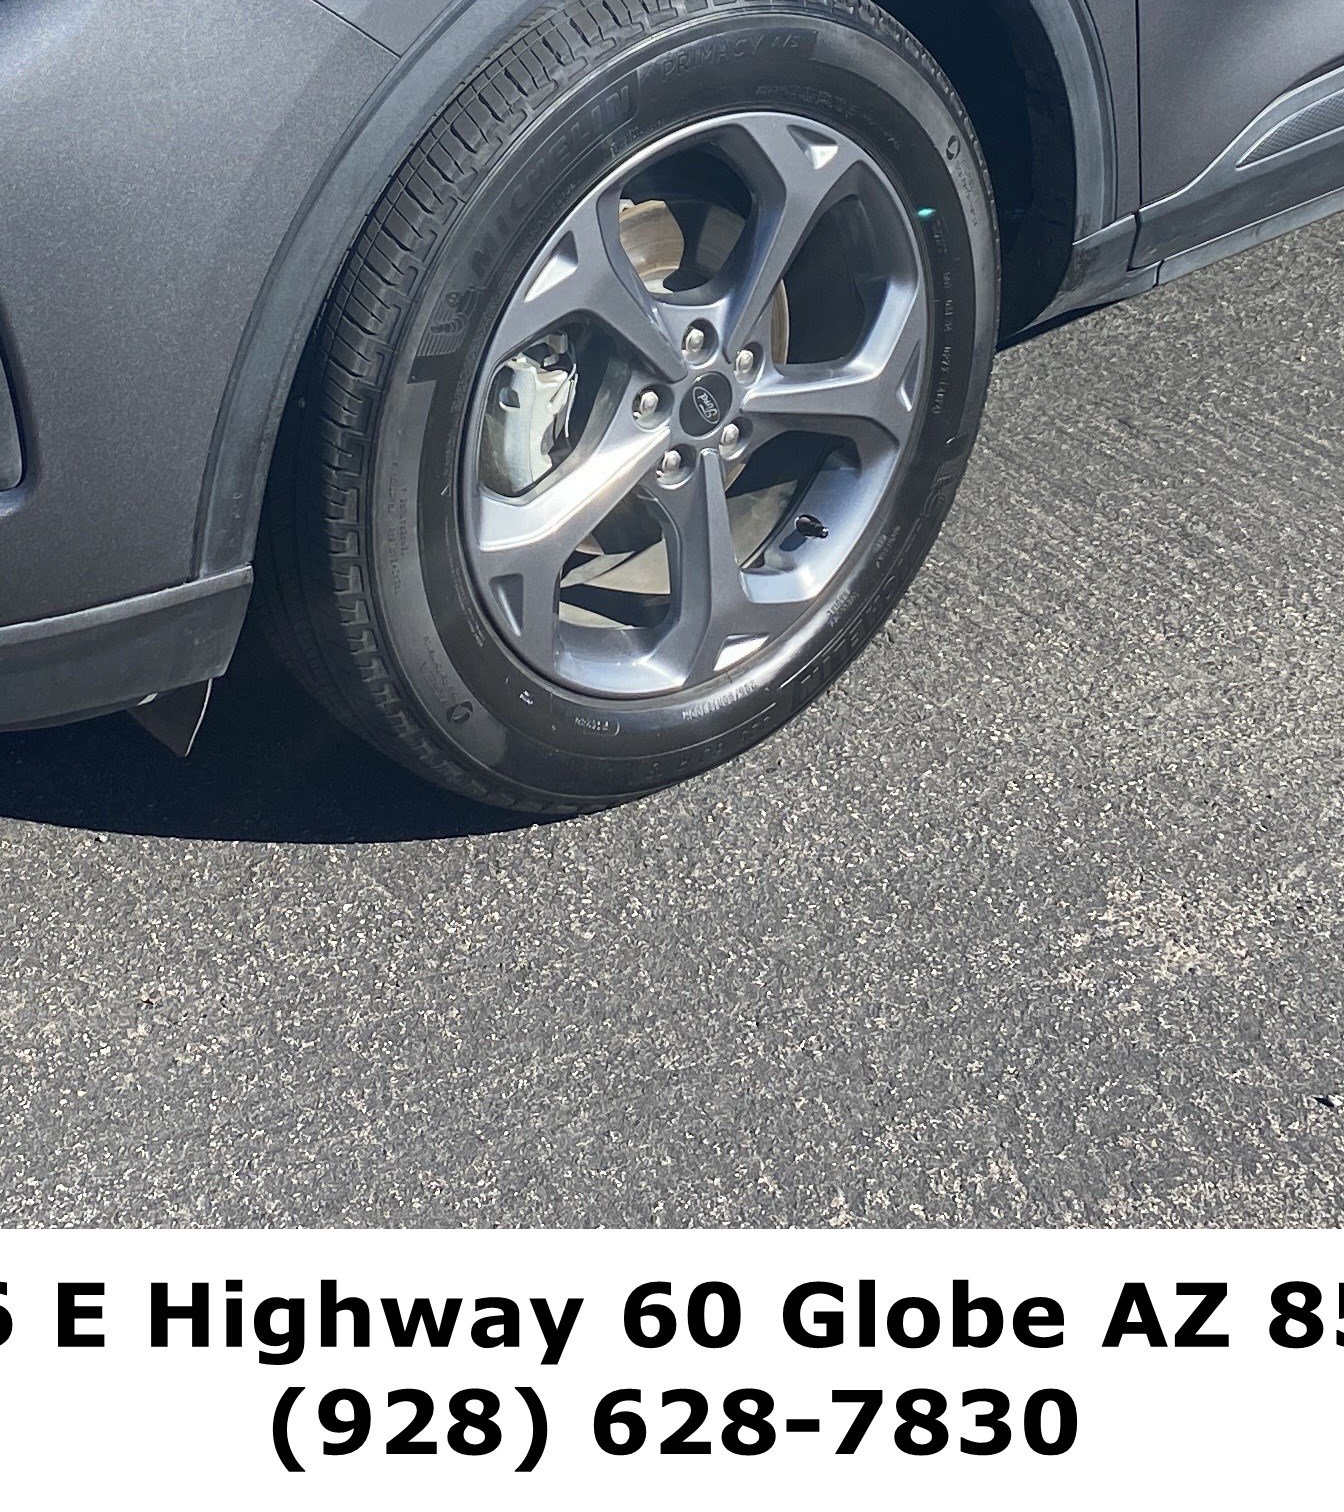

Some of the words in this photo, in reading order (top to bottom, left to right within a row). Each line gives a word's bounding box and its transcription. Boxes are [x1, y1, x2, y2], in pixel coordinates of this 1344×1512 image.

[662, 36, 764, 80] PRIMACY
[471, 84, 631, 282] MICHELIN
[697, 392, 718, 419] Ford
